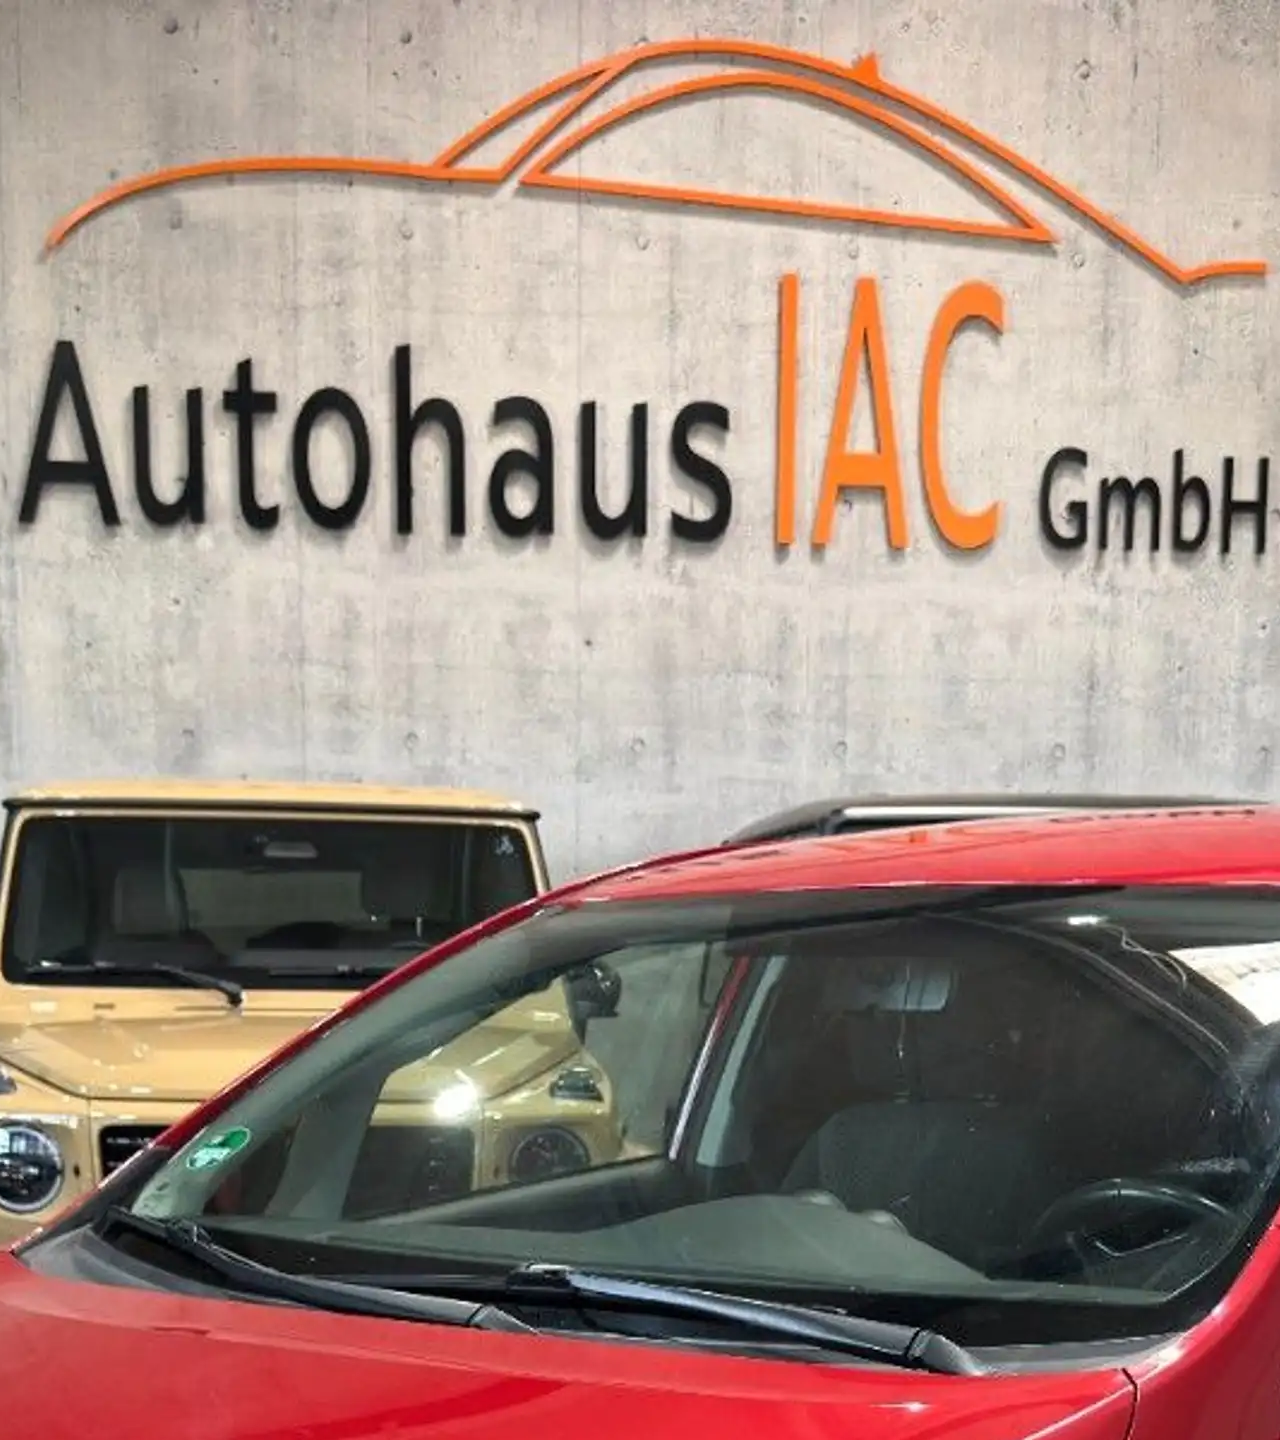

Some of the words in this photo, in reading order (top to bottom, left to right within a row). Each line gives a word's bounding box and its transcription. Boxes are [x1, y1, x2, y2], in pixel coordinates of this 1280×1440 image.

[18, 340, 733, 540] Autohaus
[775, 273, 1005, 551] IAC
[1038, 447, 1270, 556] GmbH
